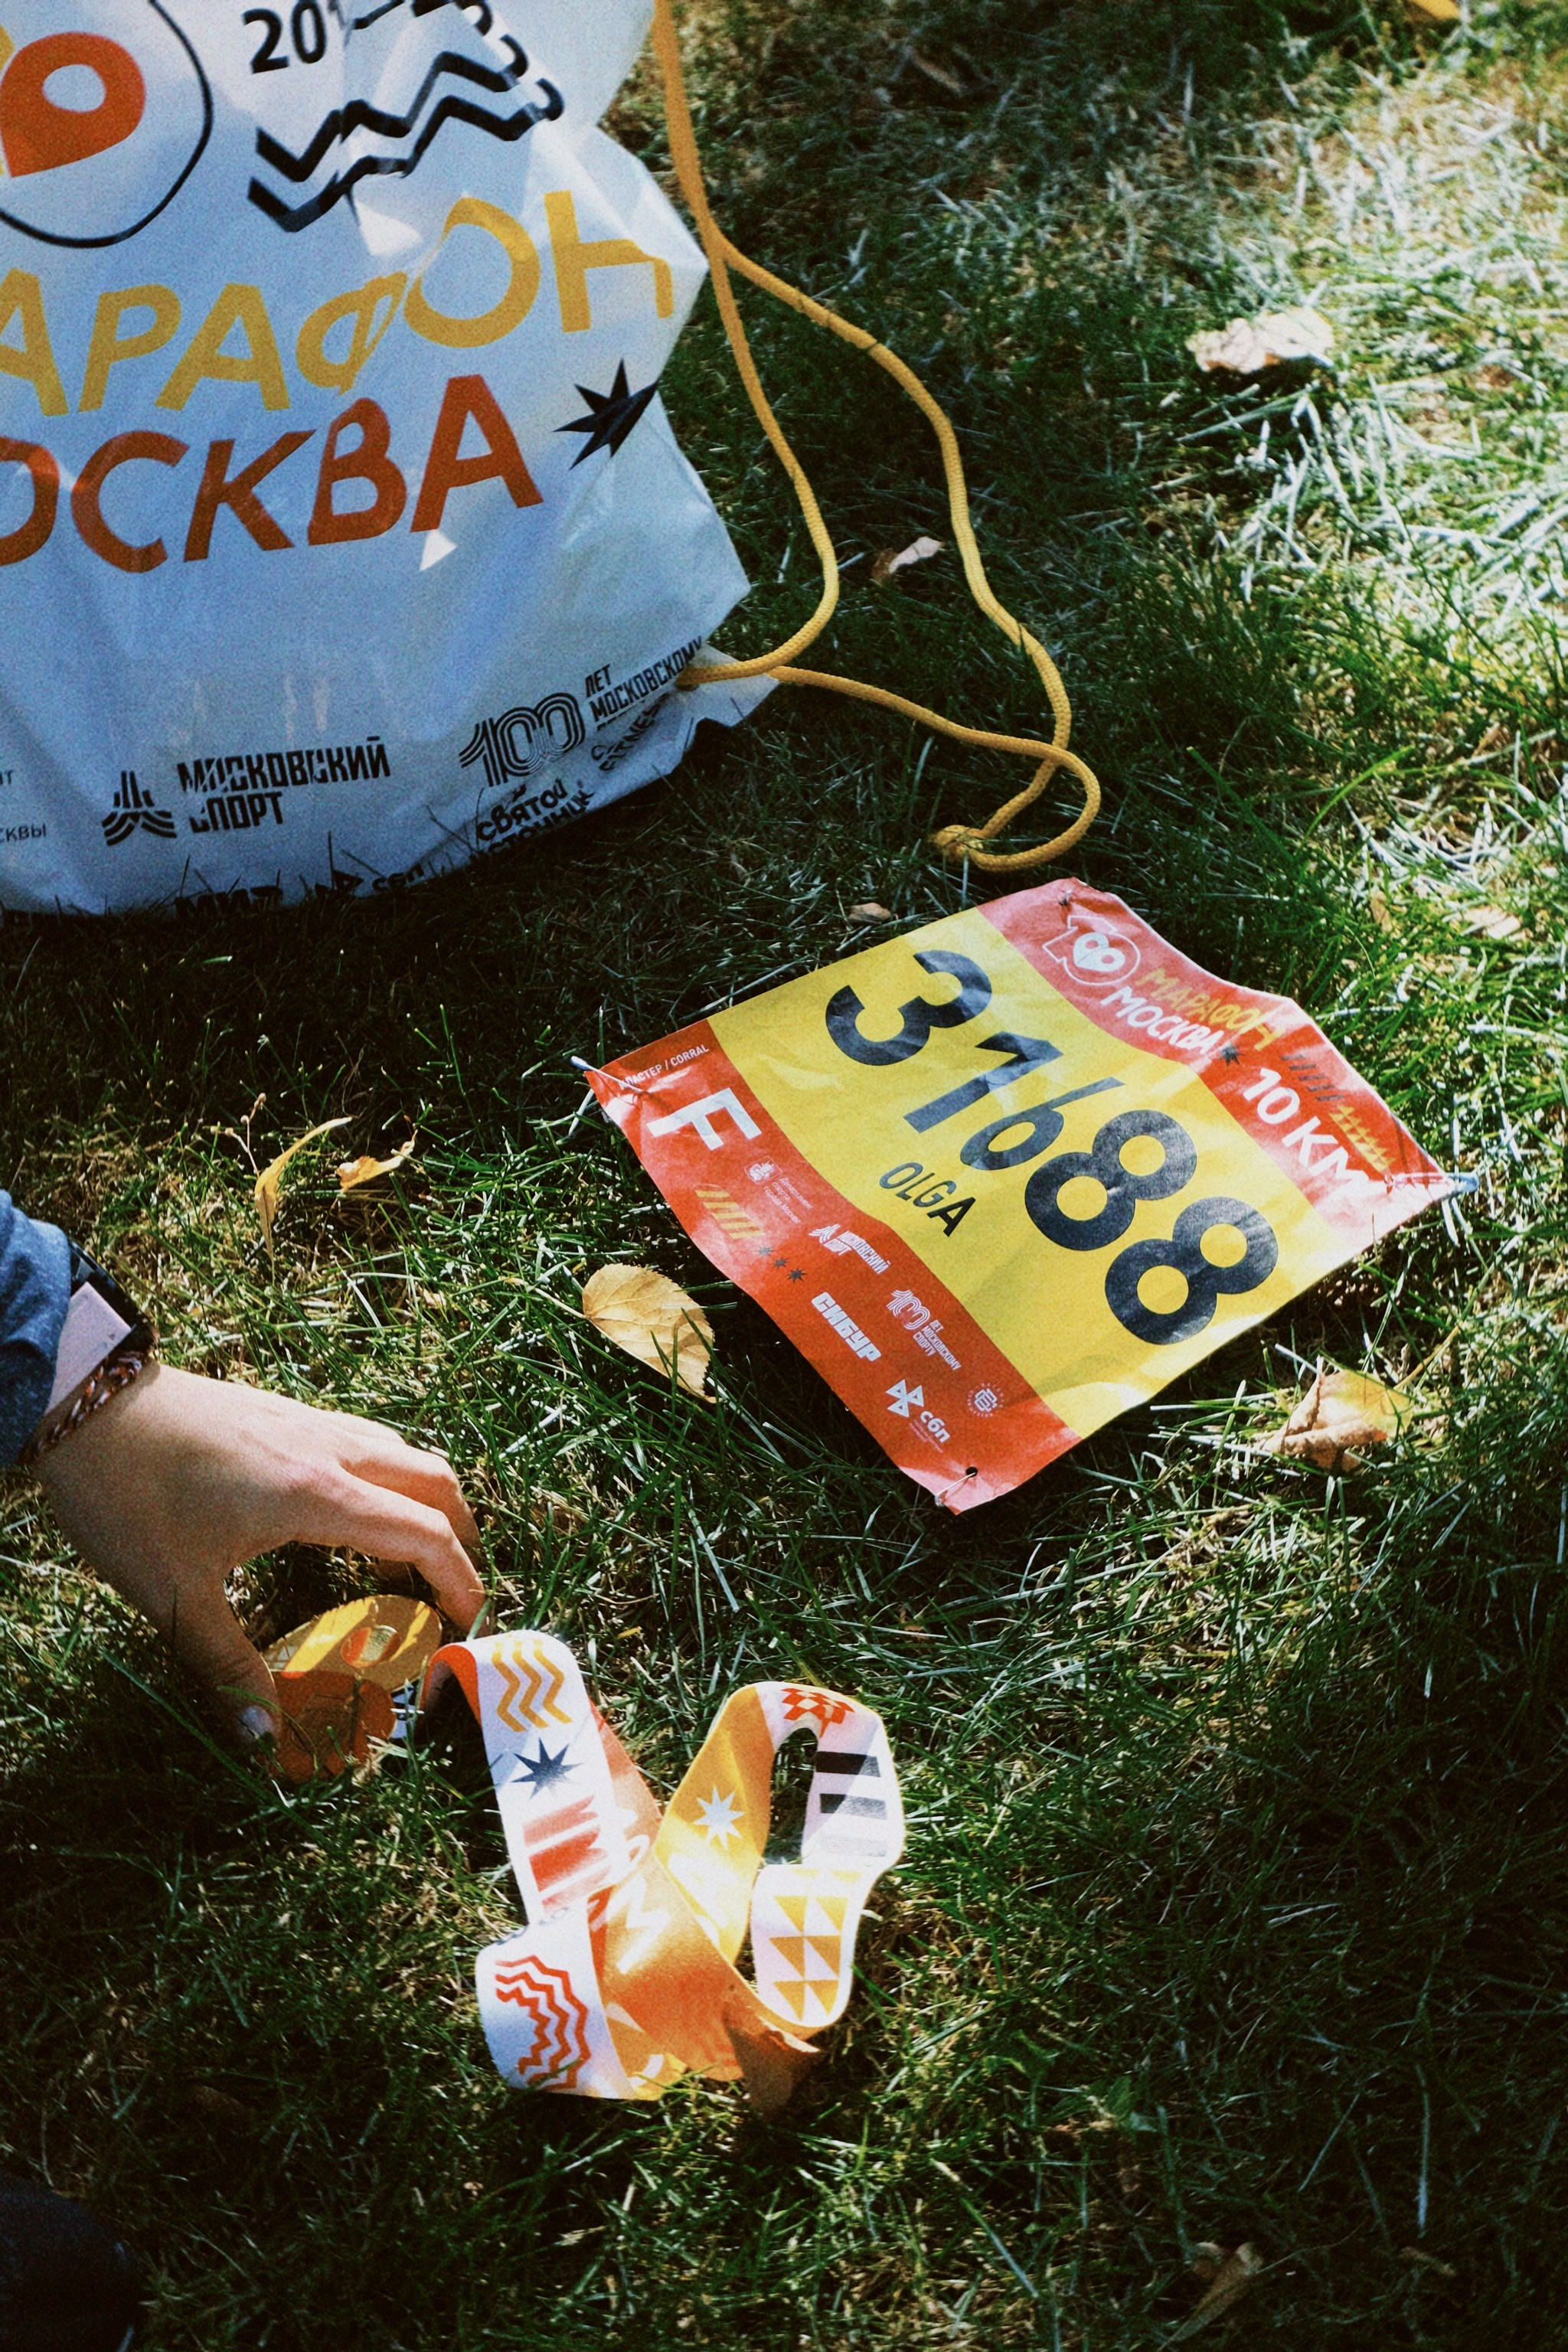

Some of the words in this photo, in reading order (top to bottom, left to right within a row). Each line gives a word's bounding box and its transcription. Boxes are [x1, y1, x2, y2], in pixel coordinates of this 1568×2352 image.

[243, 0, 346, 74] 20
[586, 665, 611, 697] ЛЕТ
[1100, 986, 1222, 1056] МОСКВА
[1136, 967, 1287, 1052] МАРАФОН
[670, 1044, 710, 1067] CORRAL
[645, 1087, 763, 1151] F
[1243, 1067, 1301, 1125] 10
[825, 949, 1279, 1345] 31688
[879, 1162, 976, 1237] OLGA
[811, 1292, 882, 1362] СИБУР
[920, 1410, 951, 1443] сбп
